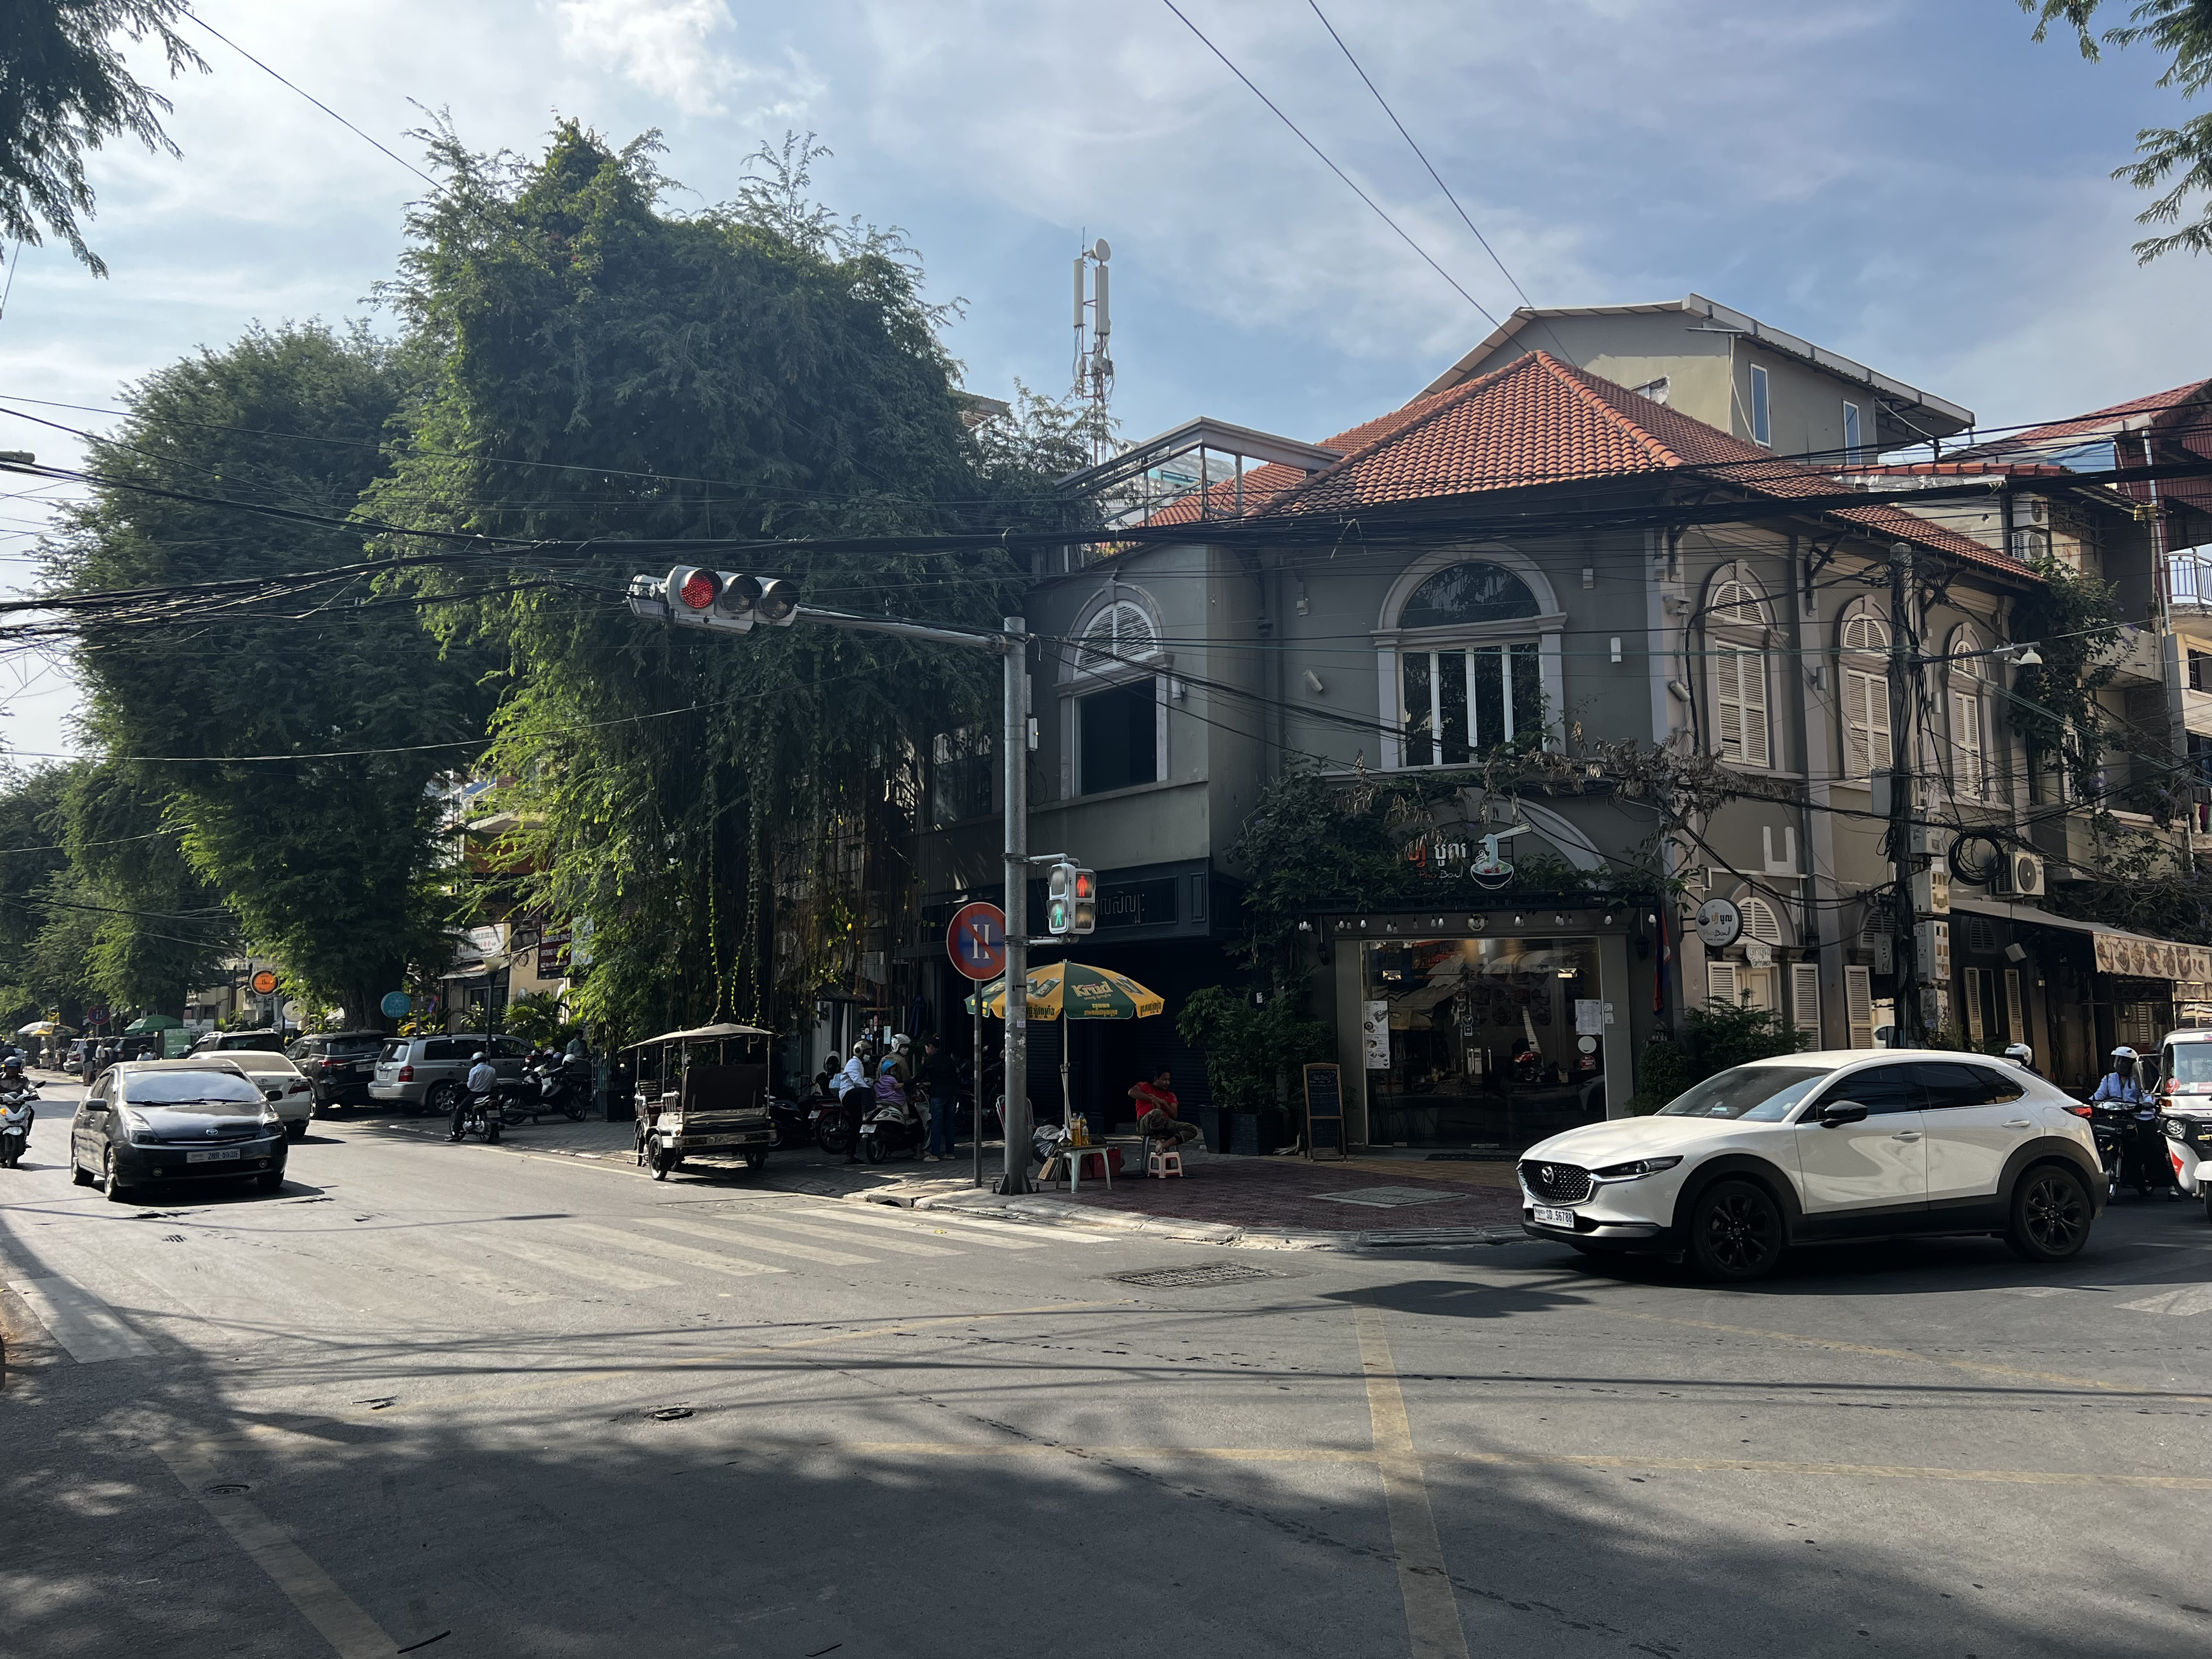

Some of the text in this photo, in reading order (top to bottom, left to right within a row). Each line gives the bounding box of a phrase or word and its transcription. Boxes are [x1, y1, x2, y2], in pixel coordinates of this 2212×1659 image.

[1417, 865, 1464, 880] Pho Bowl
[1714, 926, 1730, 938] Bowl
[1071, 980, 1113, 998] Krud
